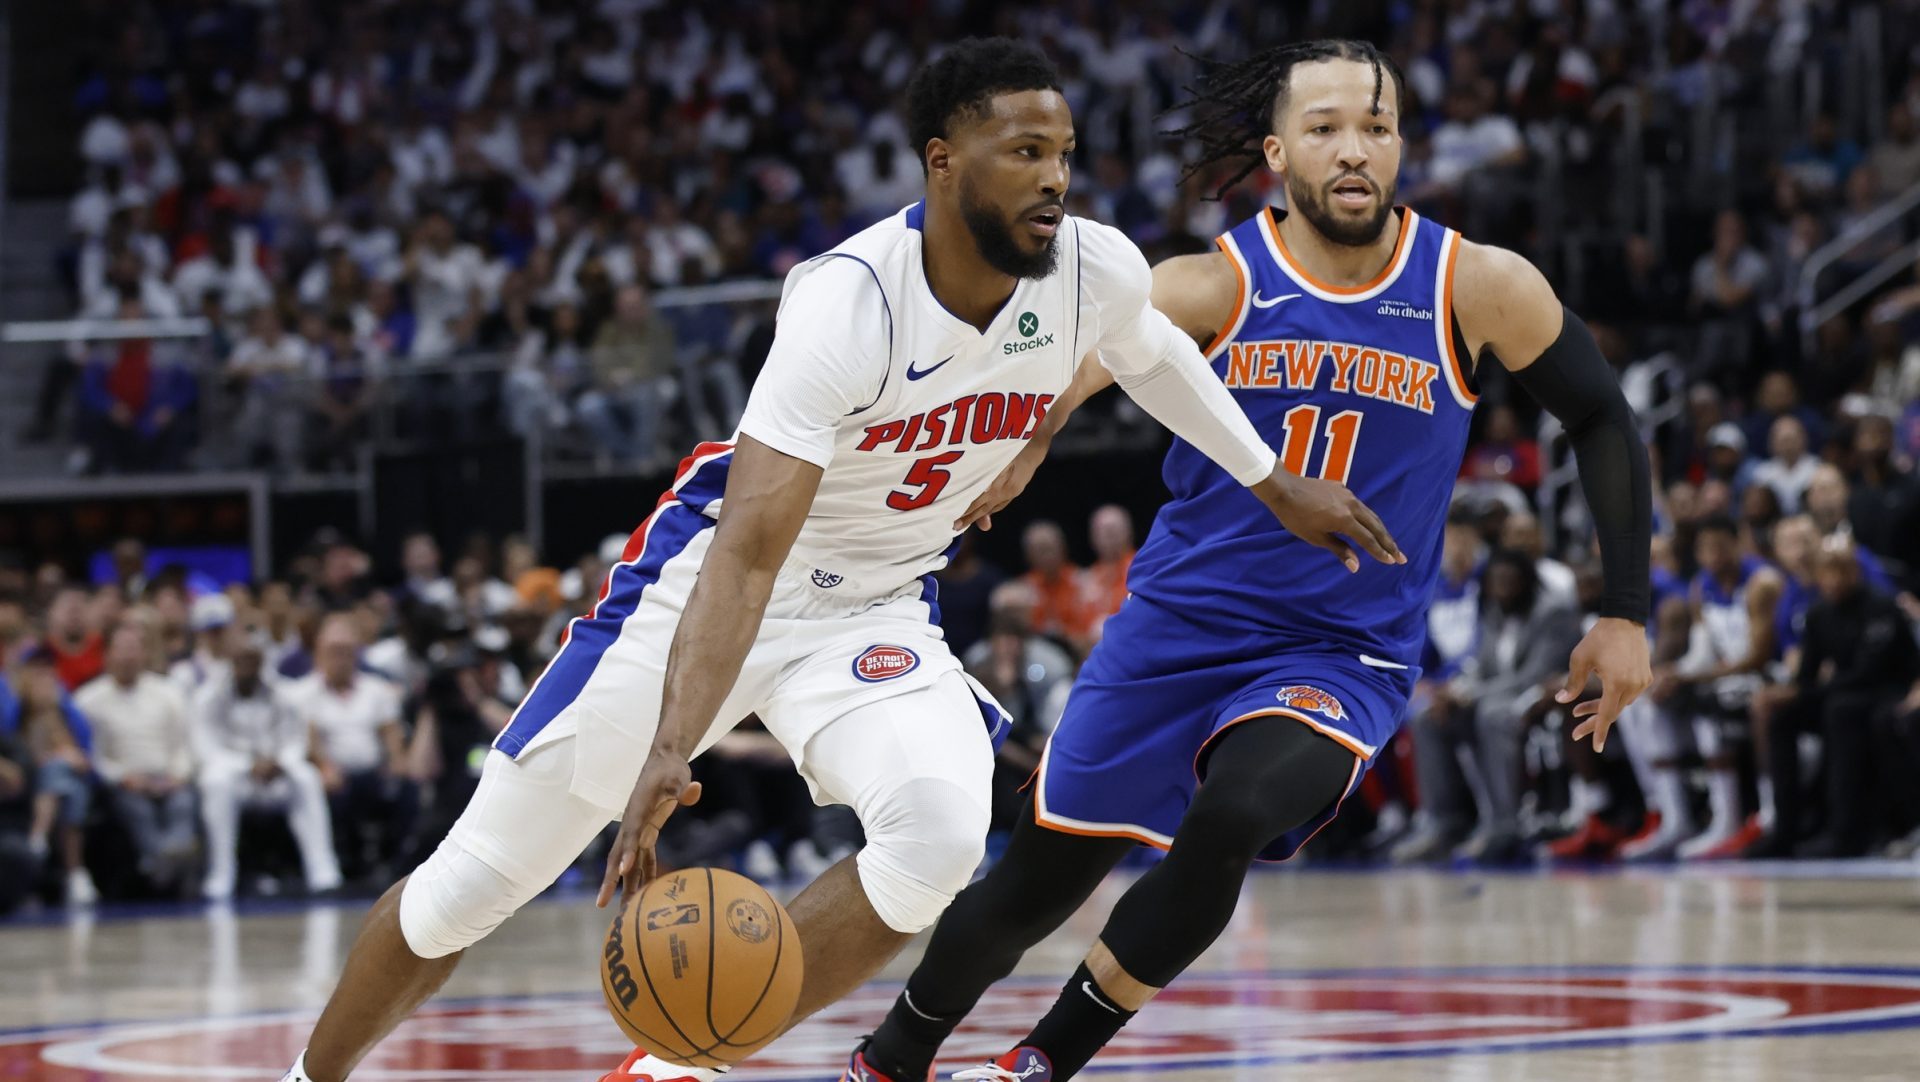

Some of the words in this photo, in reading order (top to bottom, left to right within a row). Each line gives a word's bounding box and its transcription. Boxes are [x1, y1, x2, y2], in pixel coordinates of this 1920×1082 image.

[1377, 305, 1400, 316] abu
[1402, 307, 1432, 320] dhabi
[1003, 333, 1054, 355] StockX
[1224, 340, 1327, 390] NEW
[1327, 340, 1440, 415] YORK
[855, 391, 1055, 454] PISTONS
[1282, 403, 1364, 487] 11
[886, 450, 966, 512] 5
[865, 655, 905, 665] DETROIT
[866, 660, 906, 672] PISTONS
